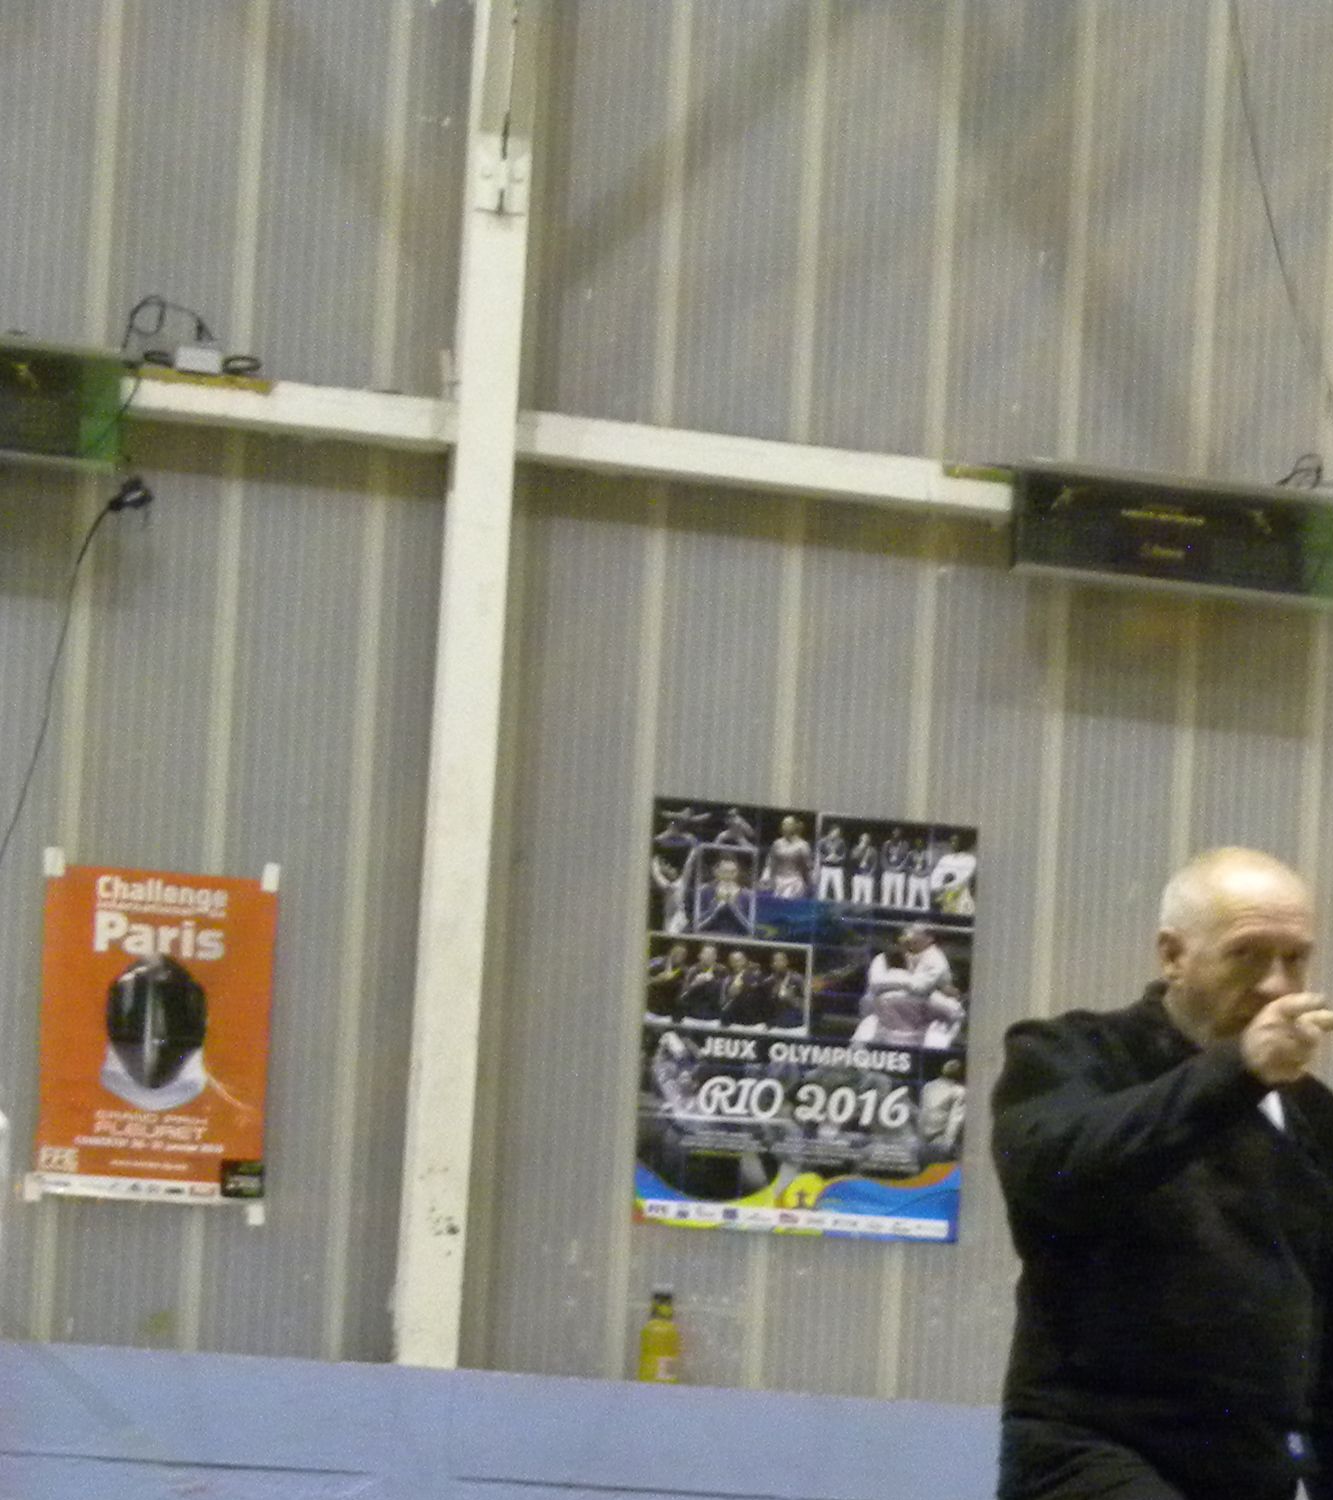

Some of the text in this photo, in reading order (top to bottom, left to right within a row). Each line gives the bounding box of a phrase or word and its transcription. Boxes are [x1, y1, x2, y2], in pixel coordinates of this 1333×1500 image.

[97, 874, 228, 913] Challenge
[94, 910, 225, 960] Paris
[701, 1036, 911, 1073] JEUX OLYMPIQUES
[700, 1075, 910, 1128] RIO 2016
